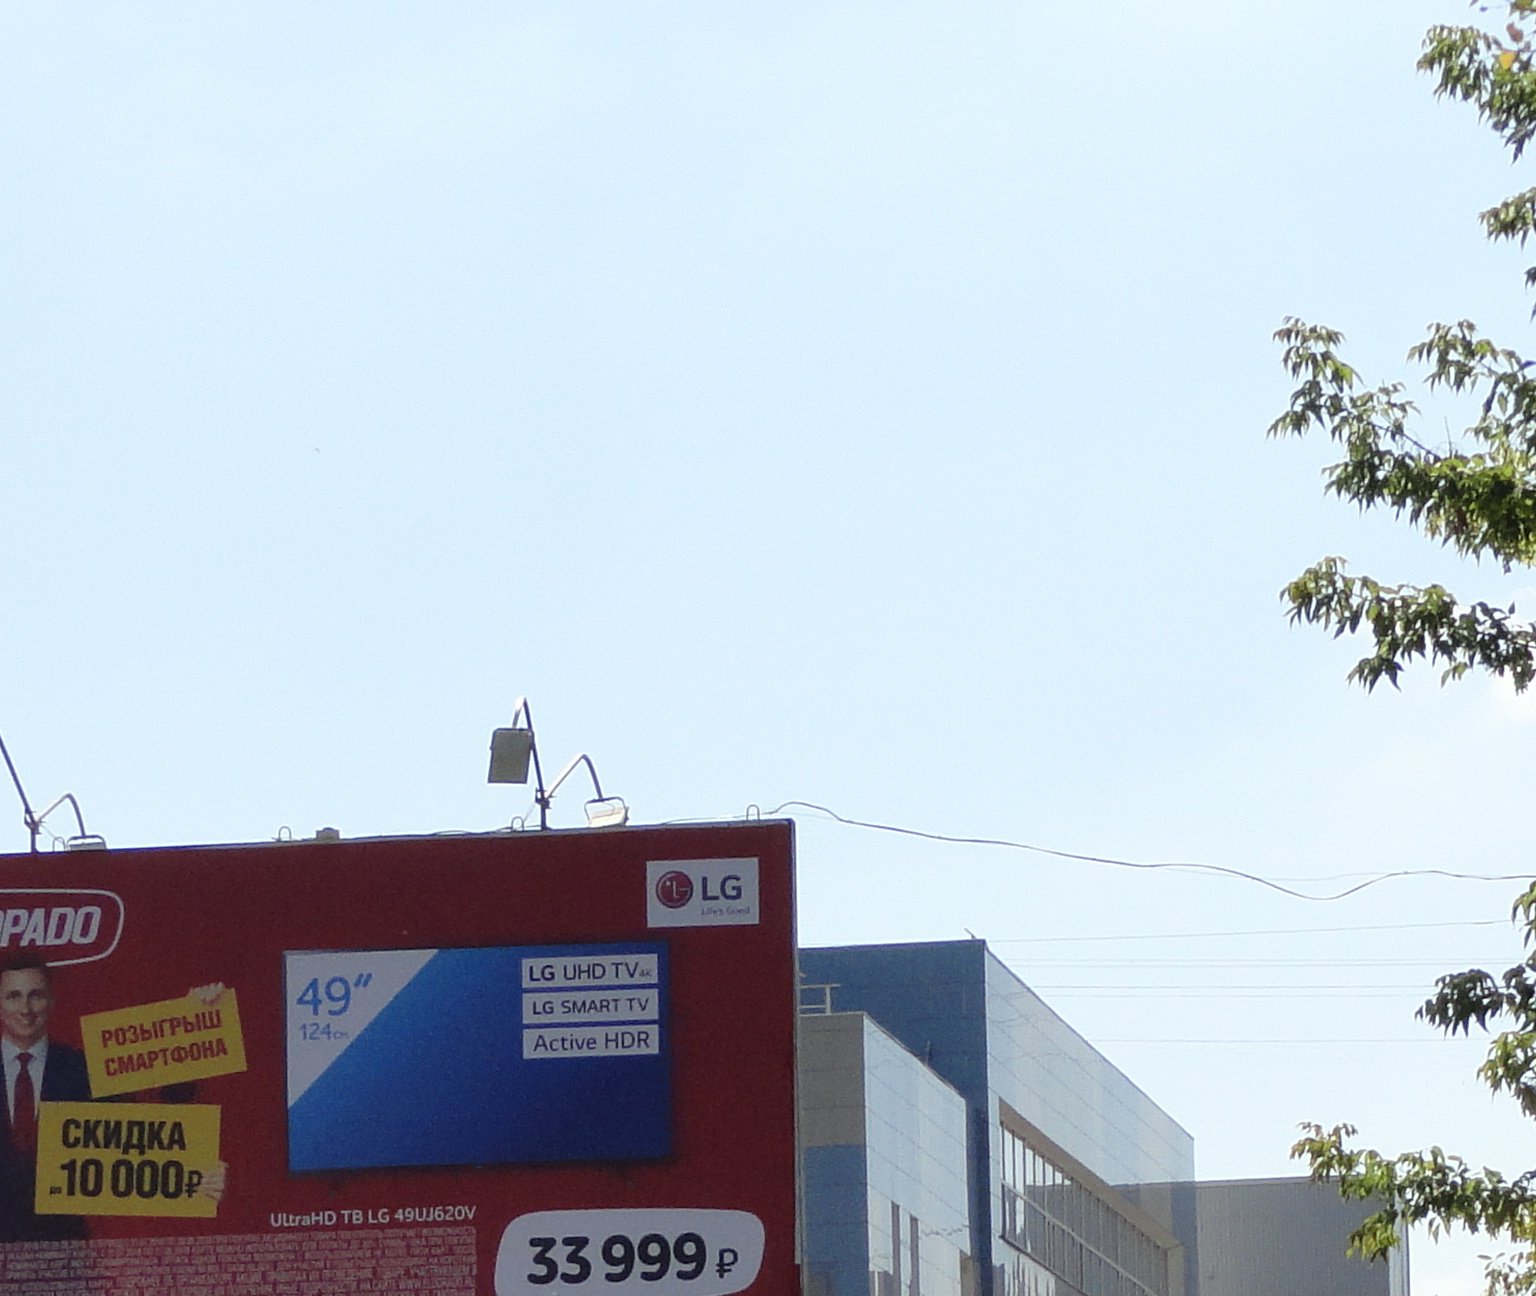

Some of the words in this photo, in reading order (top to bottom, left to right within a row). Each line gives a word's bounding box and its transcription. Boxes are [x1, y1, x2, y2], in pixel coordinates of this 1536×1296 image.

[701, 874, 743, 901] LG
[529, 964, 556, 982] LG
[563, 963, 606, 980] UHD
[532, 1001, 555, 1015] LG
[562, 998, 621, 1015] SMART
[625, 997, 650, 1012] TV
[101, 1009, 222, 1049] РОЗЫГРЫШ
[532, 1033, 597, 1053] Active
[604, 1031, 650, 1050] HDR
[104, 1037, 228, 1077] СМАРТФОНА
[61, 1118, 186, 1156] СКИДКА
[269, 1209, 337, 1228] UltraHD
[340, 1209, 364, 1225] ТВ
[368, 1208, 391, 1224] LG
[394, 1205, 478, 1222] 49UJ620V
